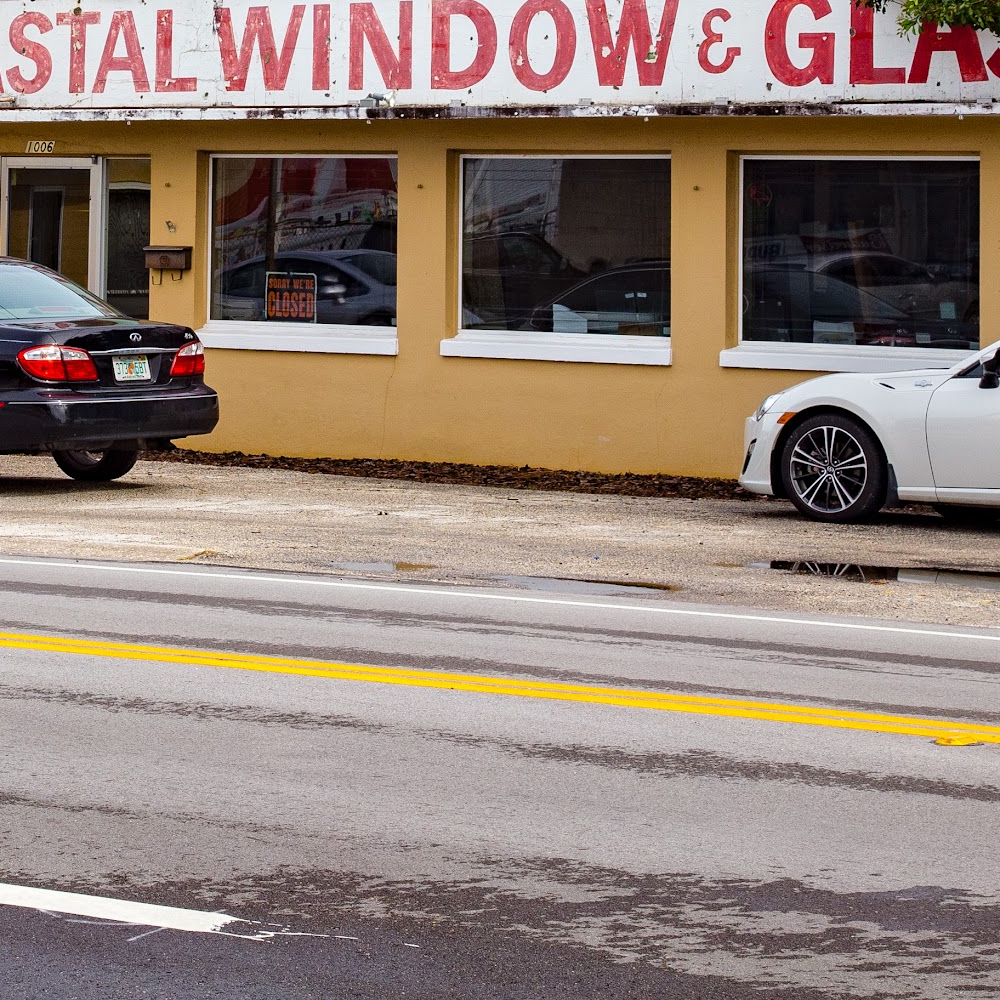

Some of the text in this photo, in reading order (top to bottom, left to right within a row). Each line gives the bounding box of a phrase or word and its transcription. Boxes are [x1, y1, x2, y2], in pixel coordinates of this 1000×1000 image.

[697, 7, 742, 75] &
[27, 141, 54, 153] 1006
[268, 277, 291, 289] SORRY
[267, 290, 315, 318] CLOSED
